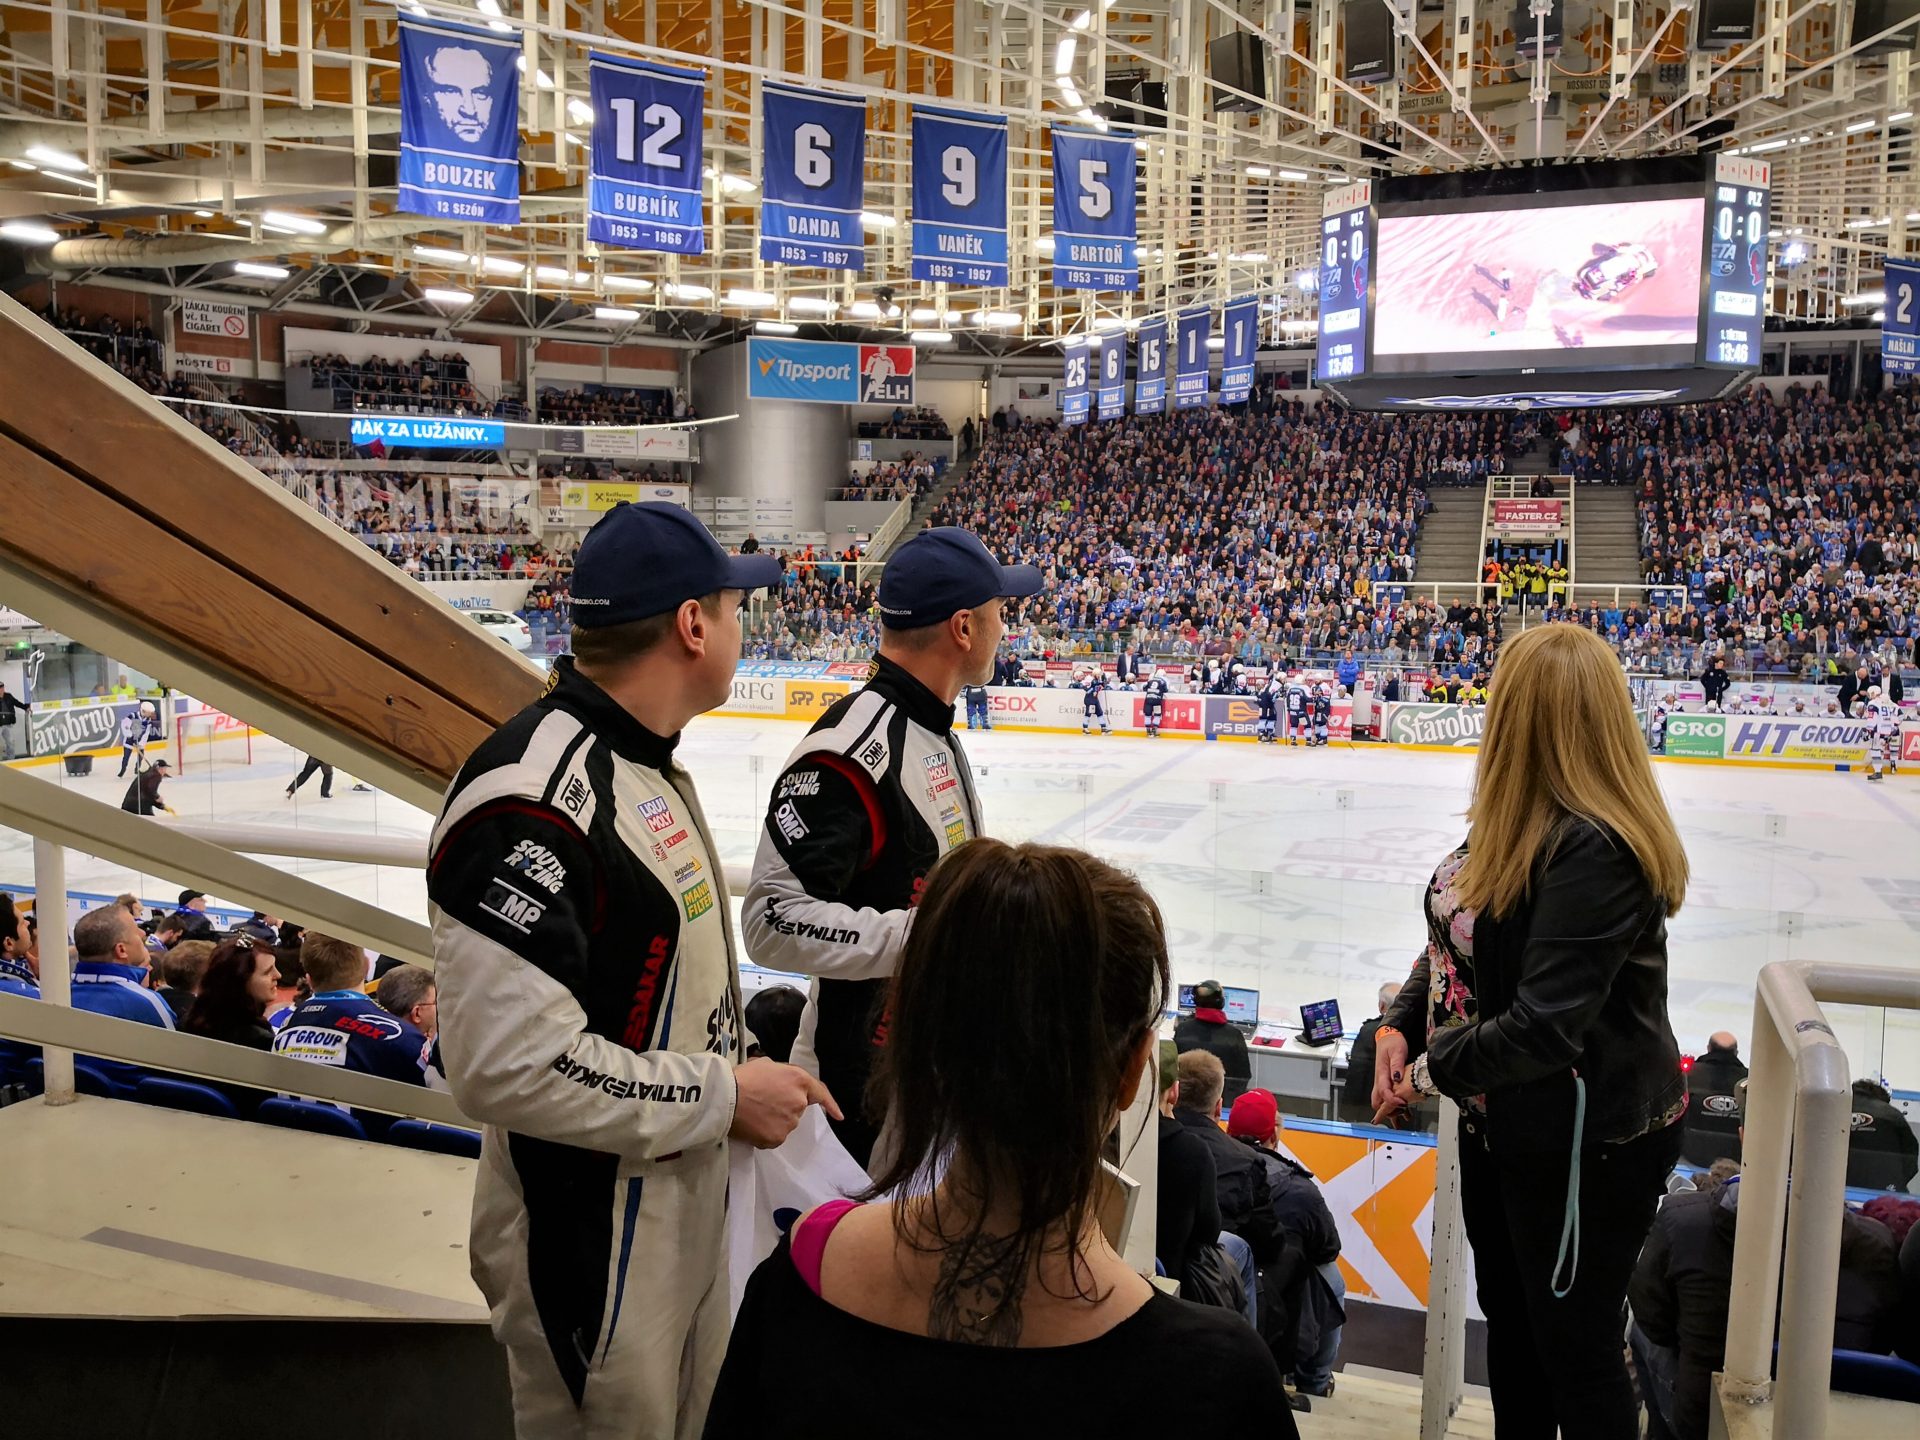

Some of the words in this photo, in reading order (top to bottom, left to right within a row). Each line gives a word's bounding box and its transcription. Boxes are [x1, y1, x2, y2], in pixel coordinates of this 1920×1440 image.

[1349, 60, 1383, 72] BOSE
[1567, 80, 1596, 89] NOSNOST
[1599, 80, 1611, 89] 125
[1421, 98, 1435, 107] 1250
[1435, 95, 1444, 105] KG
[610, 97, 681, 168] 12
[794, 122, 832, 187] 6
[424, 161, 496, 191] BOUZEK
[941, 145, 976, 207] 9
[1079, 159, 1112, 219] 5
[1748, 190, 1763, 207] PLZ
[437, 201, 449, 213] 13
[453, 201, 485, 218] SEZÓN
[614, 191, 680, 218] BUBNÍK
[611, 224, 638, 239] 1953
[655, 229, 682, 246] 1966
[788, 215, 841, 239] DANDA
[938, 233, 984, 256] VANĚK
[1070, 242, 1124, 263] BARTOŇ
[780, 246, 806, 262] 1953
[822, 250, 849, 265] 1967
[929, 265, 953, 278] 1953
[968, 268, 992, 282] 1967
[1068, 271, 1091, 283] 1953
[1103, 273, 1126, 286] 1962
[185, 301, 210, 312] ZÁKAZ
[212, 304, 246, 316] KOUŘENÍ
[1897, 283, 1912, 324] 2
[185, 322, 221, 333] CIGARET
[200, 314, 212, 322] EL.
[1188, 330, 1196, 364] 1
[1235, 320, 1243, 357] 1
[1141, 338, 1160, 373] 15
[1719, 342, 1748, 363] 13:46
[778, 359, 851, 382] Tipsport
[1067, 357, 1086, 387] 25
[1107, 349, 1117, 379] 6
[874, 384, 909, 400] ELH
[388, 422, 411, 437] ZA
[414, 420, 489, 441] LUŽÁNKY.
[1505, 512, 1558, 520] FASTER.CZ
[757, 665, 775, 673] 50
[776, 666, 801, 674] 000
[790, 691, 815, 706] SPP
[1213, 722, 1233, 732] PS
[1235, 722, 1261, 734] BR
[1732, 722, 1801, 754] HT
[864, 742, 885, 766] OMP
[924, 753, 947, 769] LIQUI
[929, 765, 948, 780] MOLY
[565, 778, 586, 812] OMP
[639, 797, 667, 817] LIQUI
[647, 811, 673, 831] MOLY
[778, 803, 805, 839] OMP
[513, 839, 567, 880] SOUTH
[683, 881, 709, 905] MANN
[296, 1030, 343, 1047] GROUP
[335, 1016, 386, 1040] ESOX
